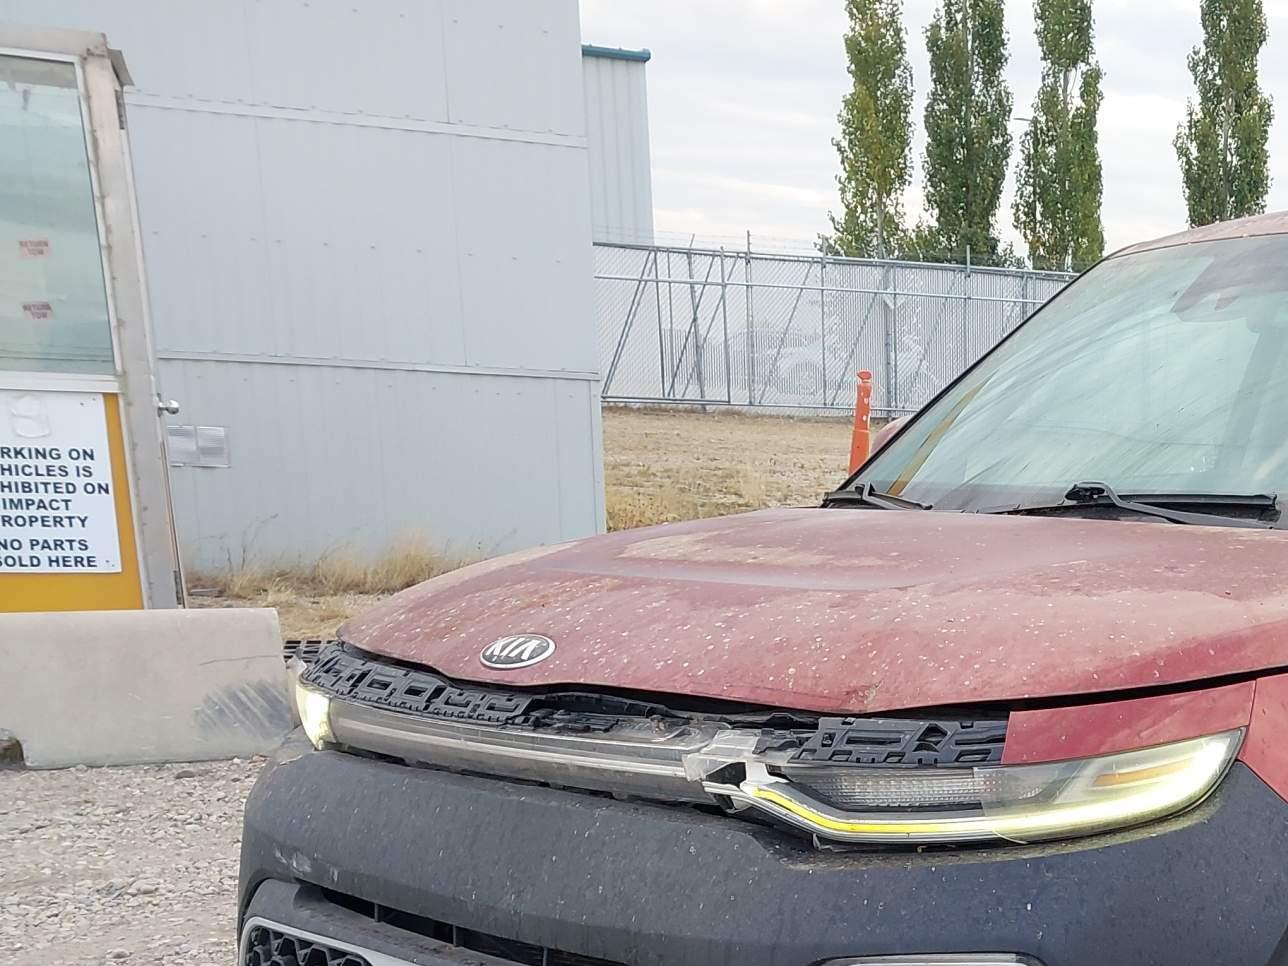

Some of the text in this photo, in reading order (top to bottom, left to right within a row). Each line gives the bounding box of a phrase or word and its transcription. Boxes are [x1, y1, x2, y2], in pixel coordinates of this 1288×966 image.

[0, 446, 95, 460] RKING ON
[0, 463, 93, 477] HICLES IS
[0, 481, 110, 495] HIBITED ON
[2, 498, 72, 511] IMPACT
[1, 515, 88, 528] ROPERTY
[0, 539, 89, 551] NO PARTS
[48, 556, 97, 567] HERE
[484, 636, 542, 661] KIA
